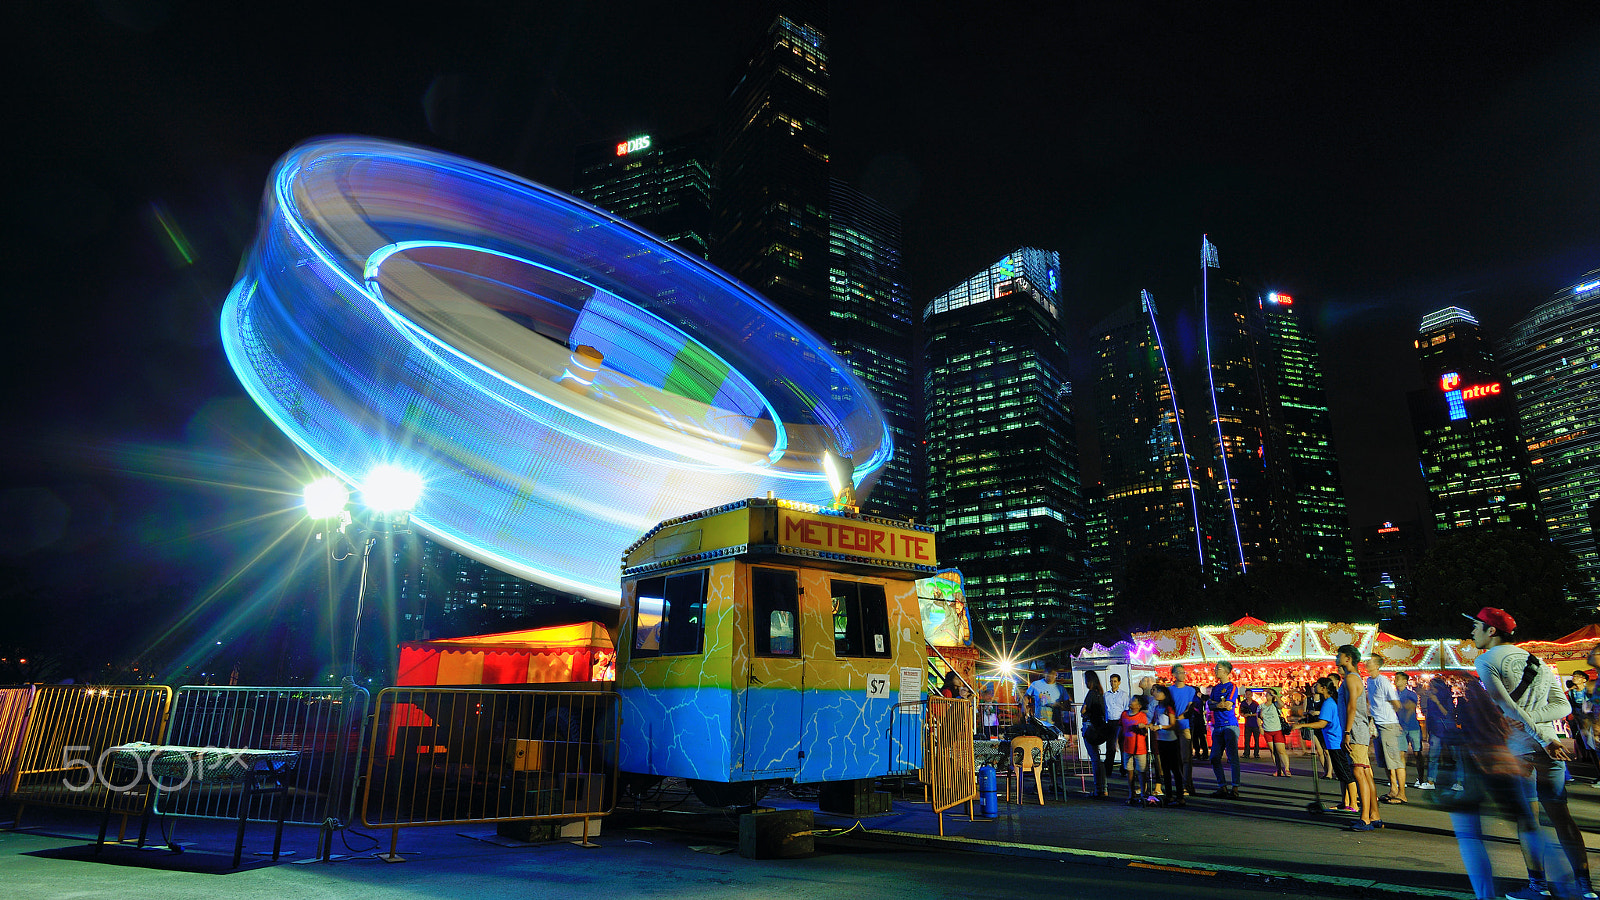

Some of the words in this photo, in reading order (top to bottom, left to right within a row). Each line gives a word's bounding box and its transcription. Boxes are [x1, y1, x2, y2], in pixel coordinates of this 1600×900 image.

[627, 135, 650, 153] DBS
[1463, 383, 1500, 400] ntuc
[785, 516, 930, 560] METEORITE
[870, 678, 886, 695] $7
